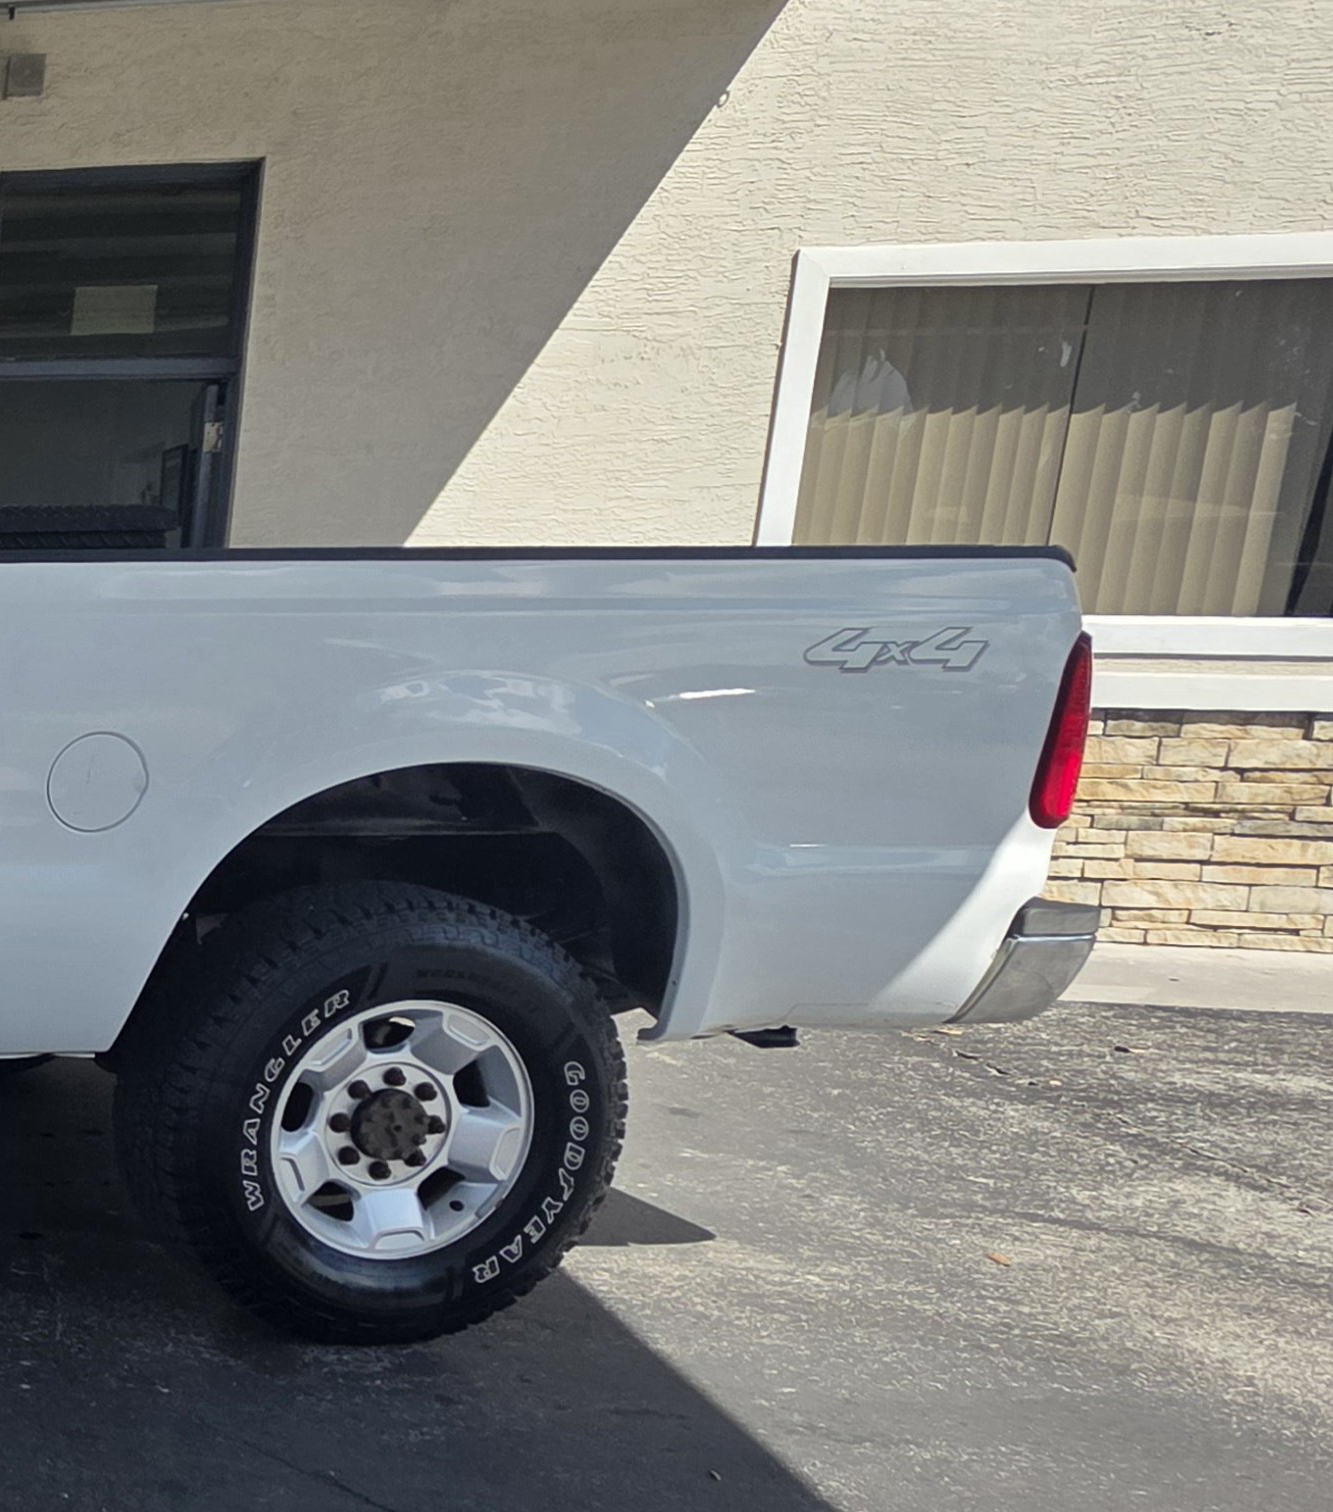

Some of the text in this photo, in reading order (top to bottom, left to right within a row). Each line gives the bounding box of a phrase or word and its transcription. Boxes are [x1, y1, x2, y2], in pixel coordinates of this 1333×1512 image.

[803, 626, 990, 672] 4x4
[240, 990, 350, 1211] WRANGLER
[473, 1061, 591, 1283] GOODYEAR
